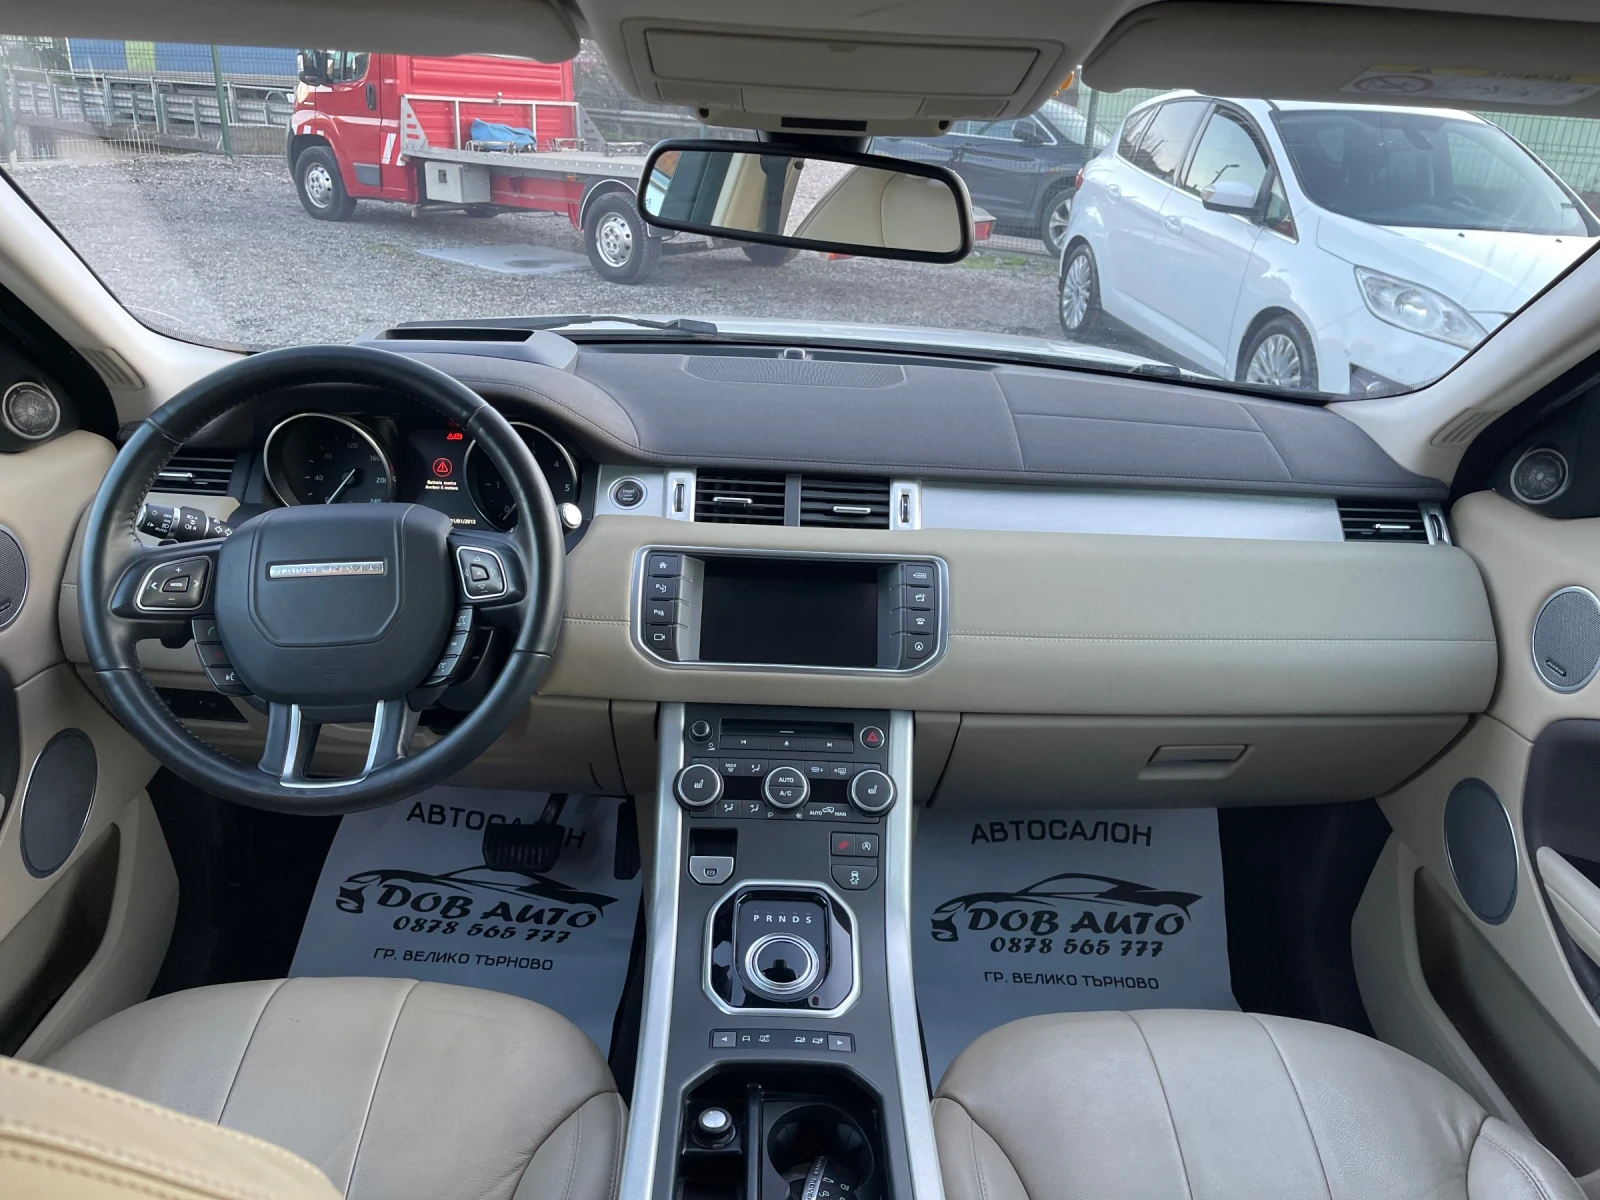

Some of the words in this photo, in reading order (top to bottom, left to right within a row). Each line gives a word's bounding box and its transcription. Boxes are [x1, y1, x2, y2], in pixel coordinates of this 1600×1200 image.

[564, 484, 570, 492] 5
[154, 526, 168, 534] AUTO
[970, 819, 1152, 847] АВТОСАЛОН
[480, 900, 597, 929] AUTO
[753, 914, 760, 922] P
[778, 915, 786, 923] N
[792, 915, 800, 923] D
[805, 916, 812, 924] S
[1069, 910, 1186, 936] AUTO
[393, 915, 461, 935] 0878
[467, 923, 518, 940] 565
[525, 928, 572, 944] 777
[989, 936, 1054, 954] 0878
[1063, 938, 1111, 956] 565
[1120, 940, 1165, 957] 777
[373, 947, 398, 961] ГР.
[402, 950, 470, 965] ВЕЛИКО
[476, 954, 554, 971] ТЪРНОВО
[984, 971, 1008, 984] ГР.
[1012, 972, 1078, 987] ВЕЛИКО
[1081, 974, 1159, 990] ТЪРНОВО
